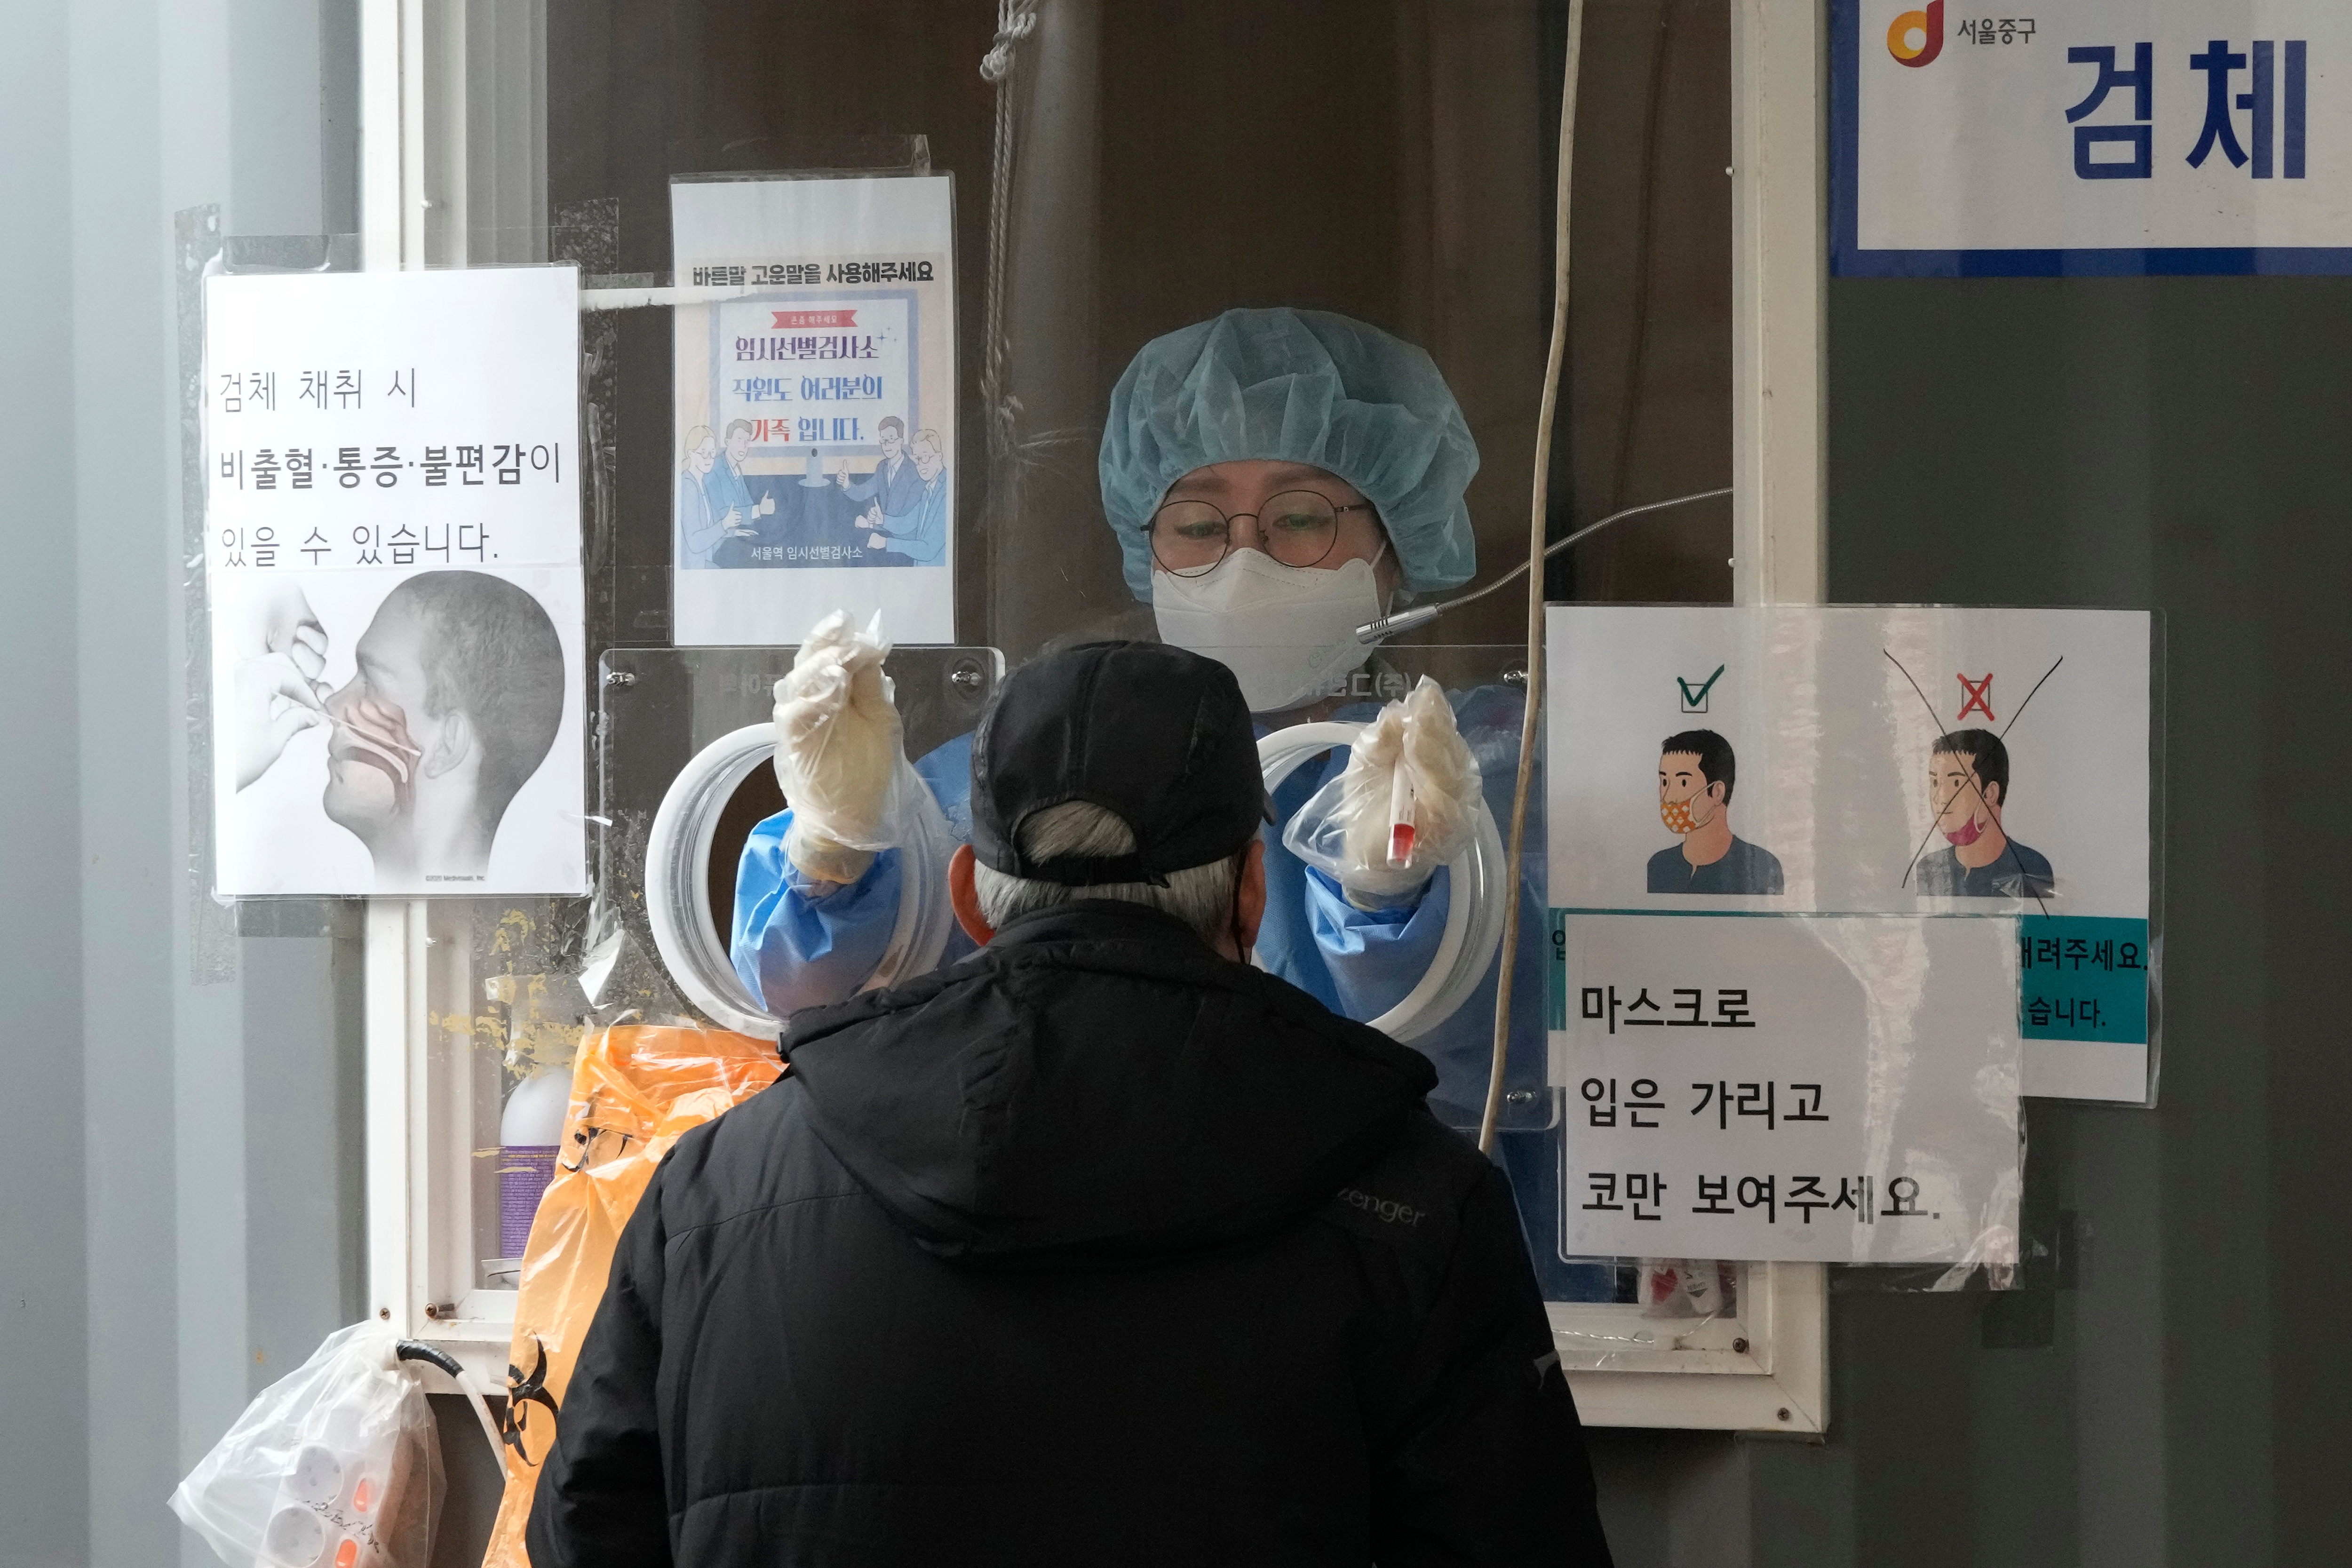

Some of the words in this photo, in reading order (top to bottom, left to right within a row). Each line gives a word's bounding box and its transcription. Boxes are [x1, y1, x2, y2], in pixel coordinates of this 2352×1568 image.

[1958, 19, 2035, 45] 서울중구
[693, 266, 746, 286] 바른말
[752, 264, 821, 285] 고운말을
[827, 261, 933, 283] 사용해주세요
[736, 336, 879, 360] 임시선별검사소
[221, 372, 275, 412] 검체
[300, 370, 361, 409] 채취
[388, 368, 414, 407] 시
[733, 377, 792, 402] 직원도
[801, 374, 882, 400] 여러분의
[751, 419, 790, 442] 가족
[799, 417, 864, 441] 입니다.
[222, 443, 559, 489] 비출혈·통증·불편감이
[223, 527, 280, 567] 있을
[301, 527, 331, 565] 수
[353, 523, 497, 565] 있습니다.
[751, 547, 782, 560] 서울역
[787, 546, 862, 559] 임시선별검사소
[1582, 986, 1755, 1034] 마스크로
[1581, 1078, 1665, 1128] 입은
[1691, 1081, 1828, 1130] 가리고
[1582, 1173, 1667, 1220] 코만
[1692, 1175, 1941, 1225] 보여주세요.
